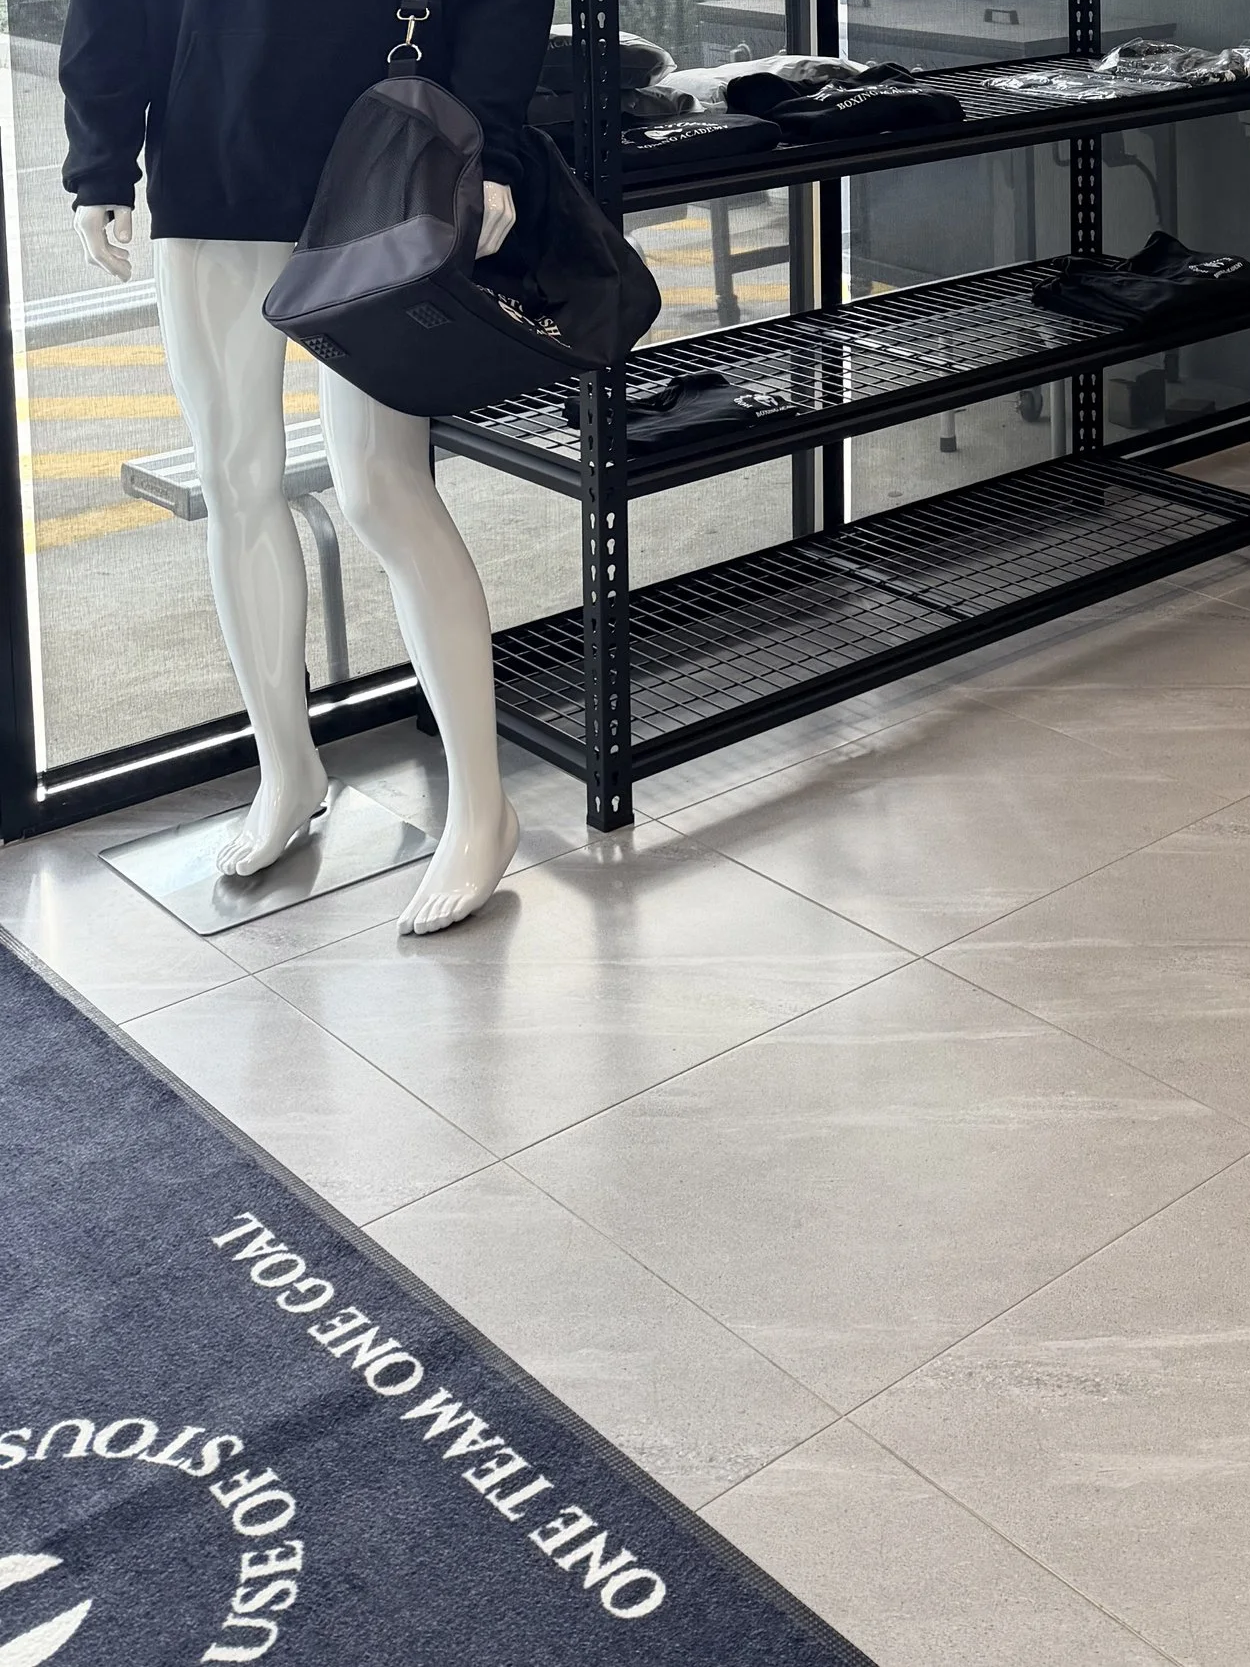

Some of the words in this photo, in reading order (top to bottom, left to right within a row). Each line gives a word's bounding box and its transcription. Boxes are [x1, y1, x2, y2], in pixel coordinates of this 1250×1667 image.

[836, 90, 879, 110] BOXING
[212, 1212, 335, 1314] GOAL
[308, 1306, 424, 1397] ONE
[209, 1467, 296, 1536] OF
[400, 1387, 555, 1522] TEAM
[529, 1504, 667, 1620] ONE
